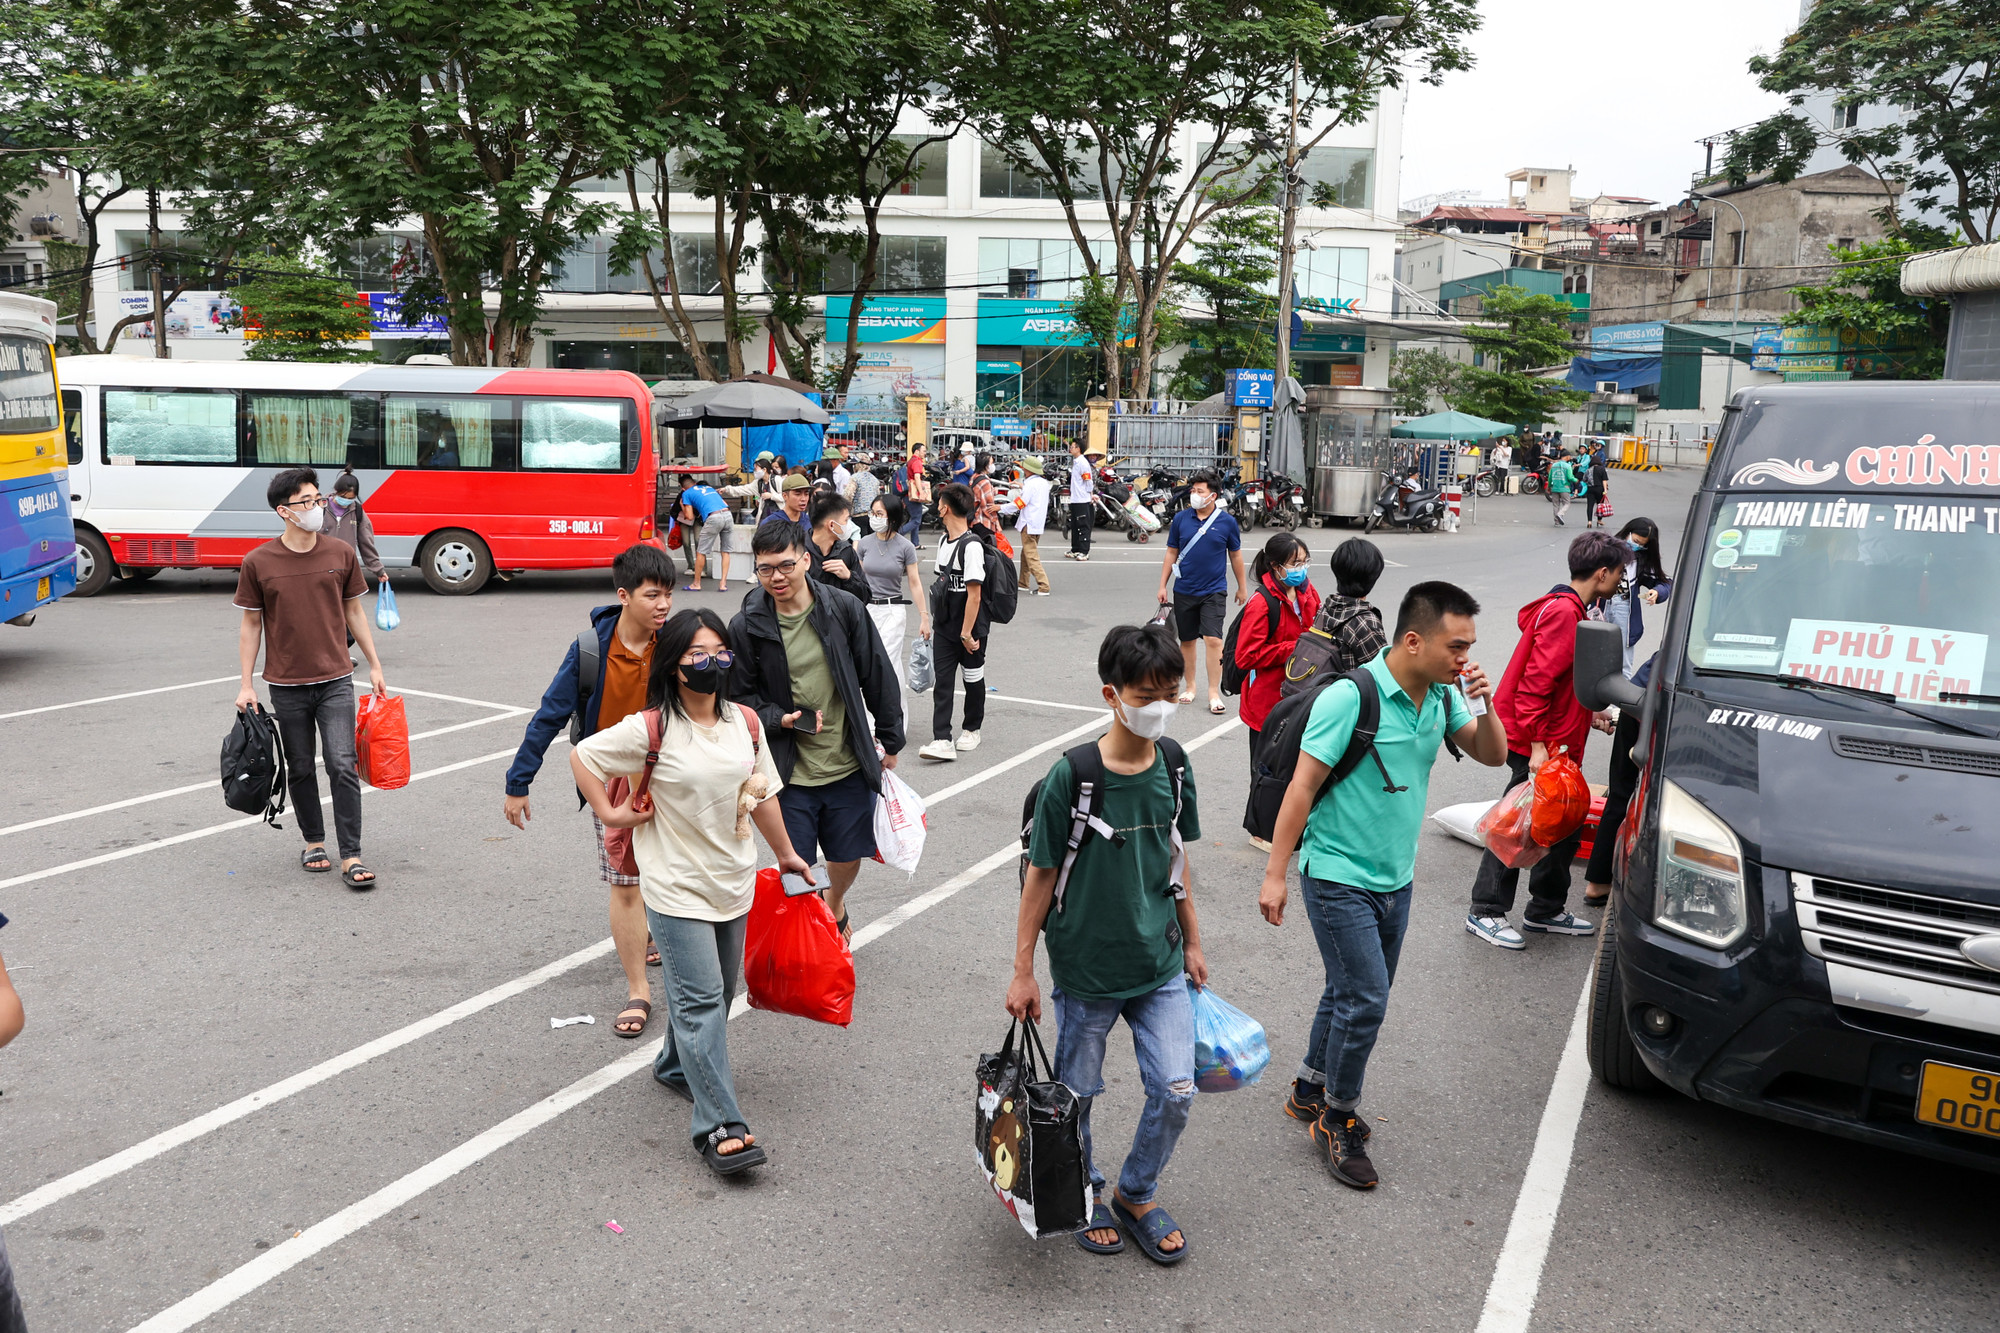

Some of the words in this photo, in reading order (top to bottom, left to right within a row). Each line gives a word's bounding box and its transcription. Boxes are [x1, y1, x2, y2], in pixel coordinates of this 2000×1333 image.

[846, 316, 920, 327] BBANK
[1613, 329, 1641, 340] FITNESS
[0, 342, 20, 372] ÀNH
[866, 352, 893, 360] UPAS
[1250, 382, 1260, 395] 2
[1259, 372, 1273, 381] VÀO
[1845, 433, 2000, 486] CHÍNH
[549, 519, 603, 534] 35B-008.41
[1733, 501, 1808, 527] THANH
[1809, 498, 1870, 529] LIÊM
[1984, 507, 2000, 535] T
[1812, 625, 1894, 660] PHỦ
[1905, 634, 1955, 666] LÝ
[1788, 662, 1885, 694] THANH
[1892, 669, 1971, 706] LIÊM
[1706, 708, 1735, 725] BX
[1731, 711, 1756, 727] TT
[1777, 719, 1823, 741] NAM
[1969, 1075, 2000, 1105] 9
[1936, 1098, 2000, 1133] 000
